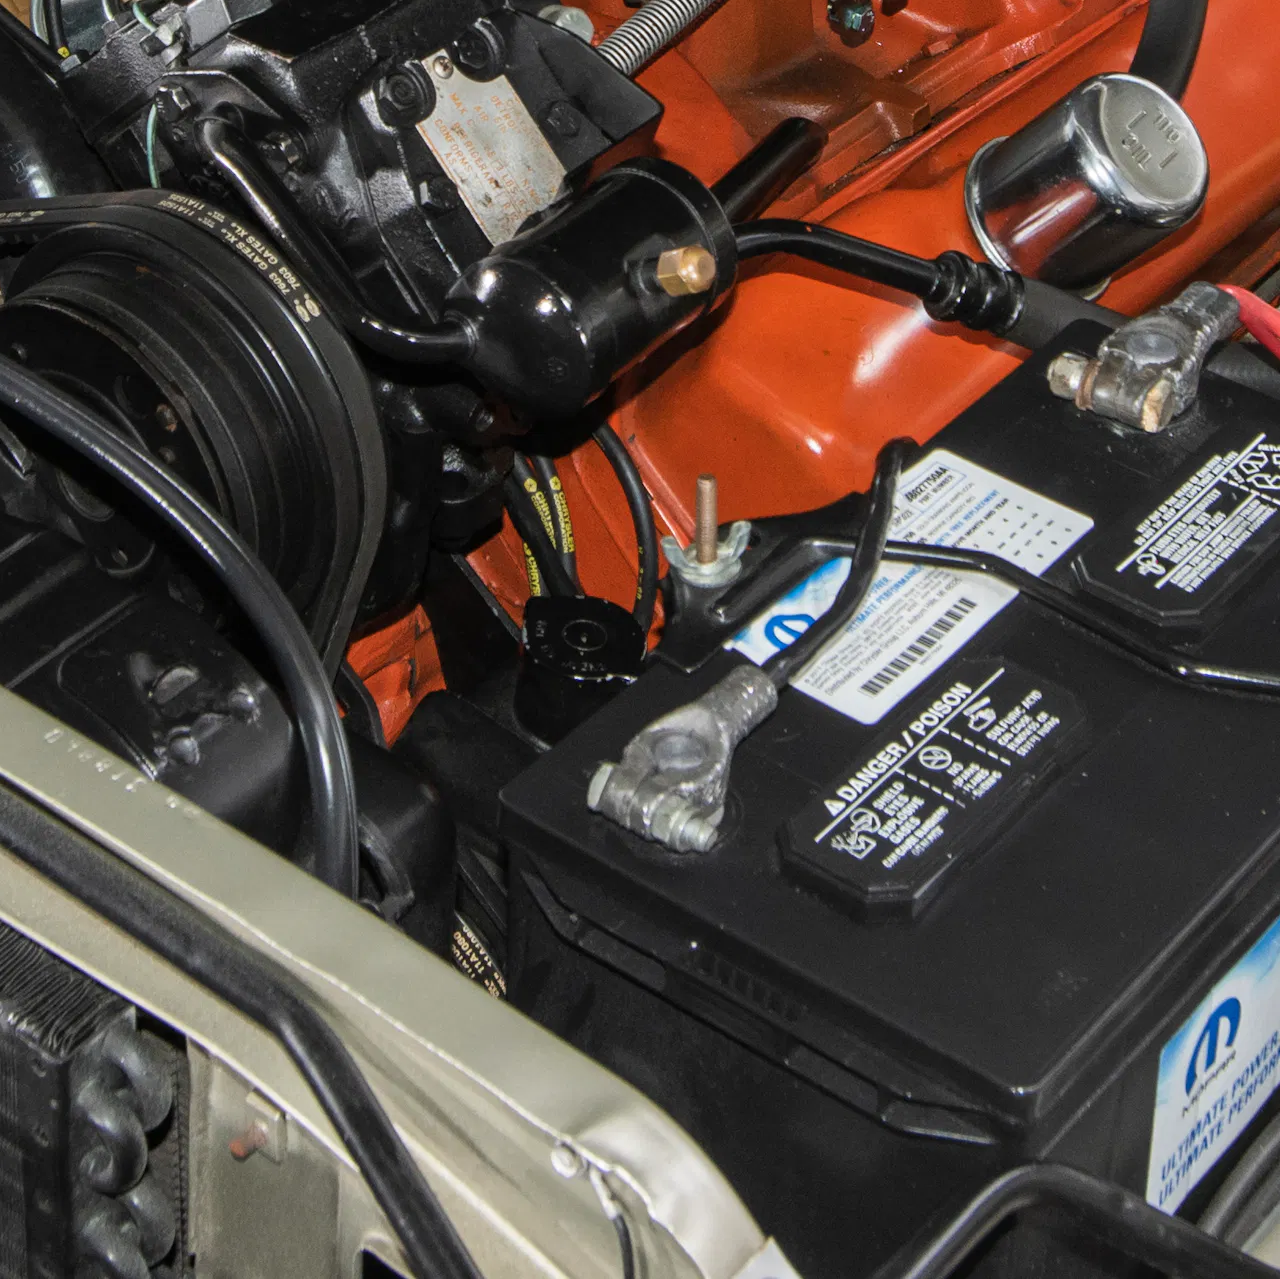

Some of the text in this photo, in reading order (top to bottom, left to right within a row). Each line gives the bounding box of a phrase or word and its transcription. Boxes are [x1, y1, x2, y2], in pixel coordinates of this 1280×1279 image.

[448, 91, 468, 115] MAX
[433, 117, 473, 174] CONFORMS
[450, 121, 501, 192] REFRIGERANT
[235, 240, 291, 296] 7603 GATES
[246, 234, 301, 290] 7603 GATES
[916, 474, 956, 505] PART NUMBER
[959, 489, 1001, 521] REPLACEMENT
[992, 497, 1011, 511] YEAR
[557, 490, 576, 554] CHRYSLER
[857, 646, 885, 667] Chrysler
[876, 633, 900, 650] Group
[981, 688, 1045, 741] SULFURIC ACID
[831, 739, 911, 803] DANGER
[904, 679, 976, 736] POISON
[943, 760, 967, 777] NO
[868, 779, 909, 811] SHIELD
[873, 794, 928, 838] EXPLOSIVE
[880, 791, 913, 816] EYES
[885, 814, 924, 845] GASES
[1161, 1029, 1280, 1182] ULTIMATE POWER
[1158, 1122, 1225, 1207] ULTIMATE
